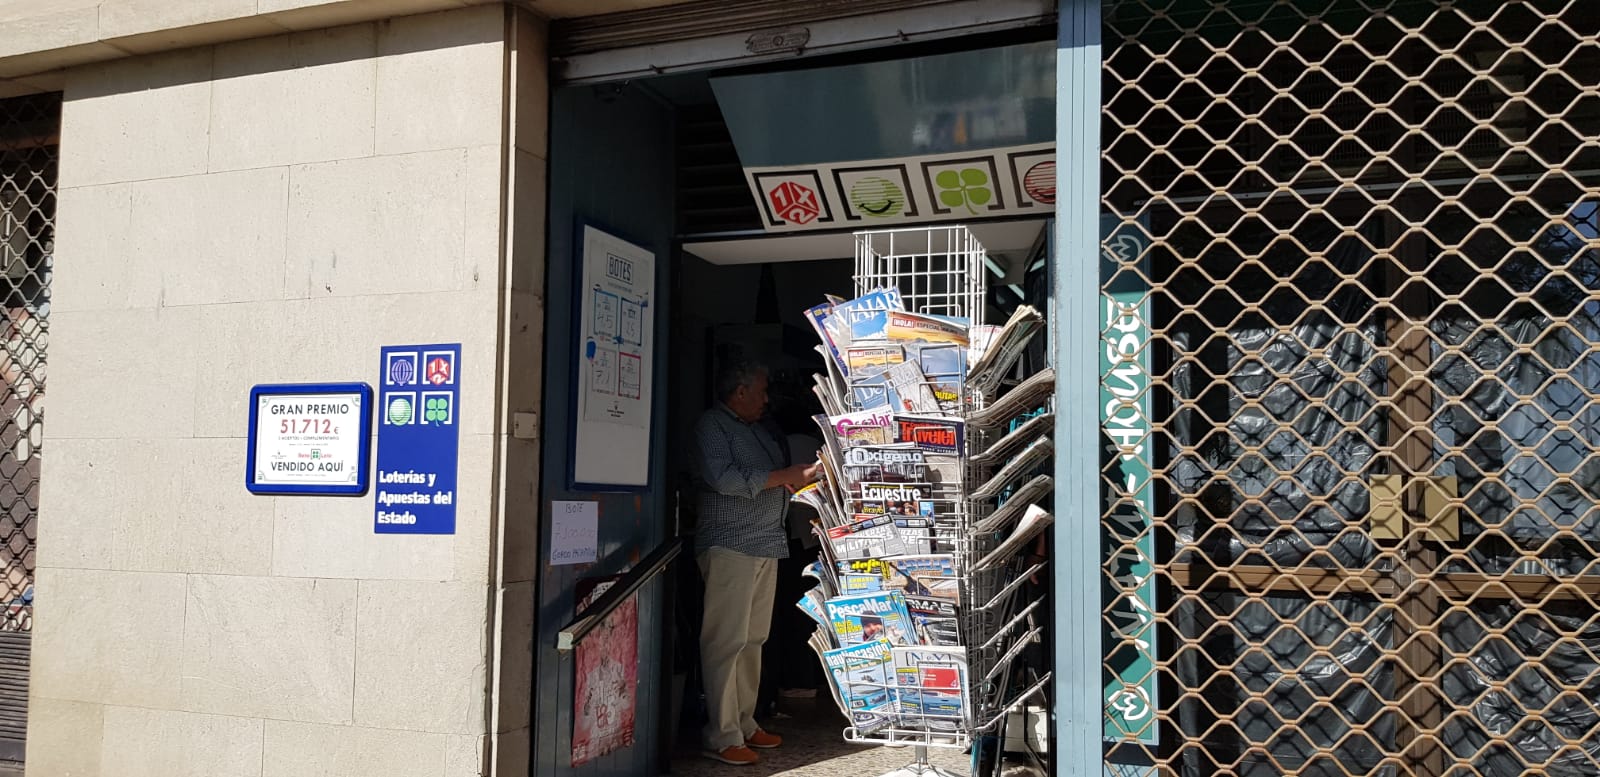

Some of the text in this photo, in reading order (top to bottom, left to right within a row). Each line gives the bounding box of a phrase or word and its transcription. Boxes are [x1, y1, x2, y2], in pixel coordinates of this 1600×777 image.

[608, 257, 632, 281] BOTES
[271, 403, 349, 415] GRAN PREMIO
[280, 419, 331, 434] 51.712
[270, 460, 344, 472] VENDIDO AQUÍ
[379, 470, 436, 487] Loterías y
[378, 491, 452, 506] Apuestas del
[861, 483, 922, 502] Ecuestre
[377, 511, 416, 525] Estado
[828, 597, 893, 620] PescaMar
